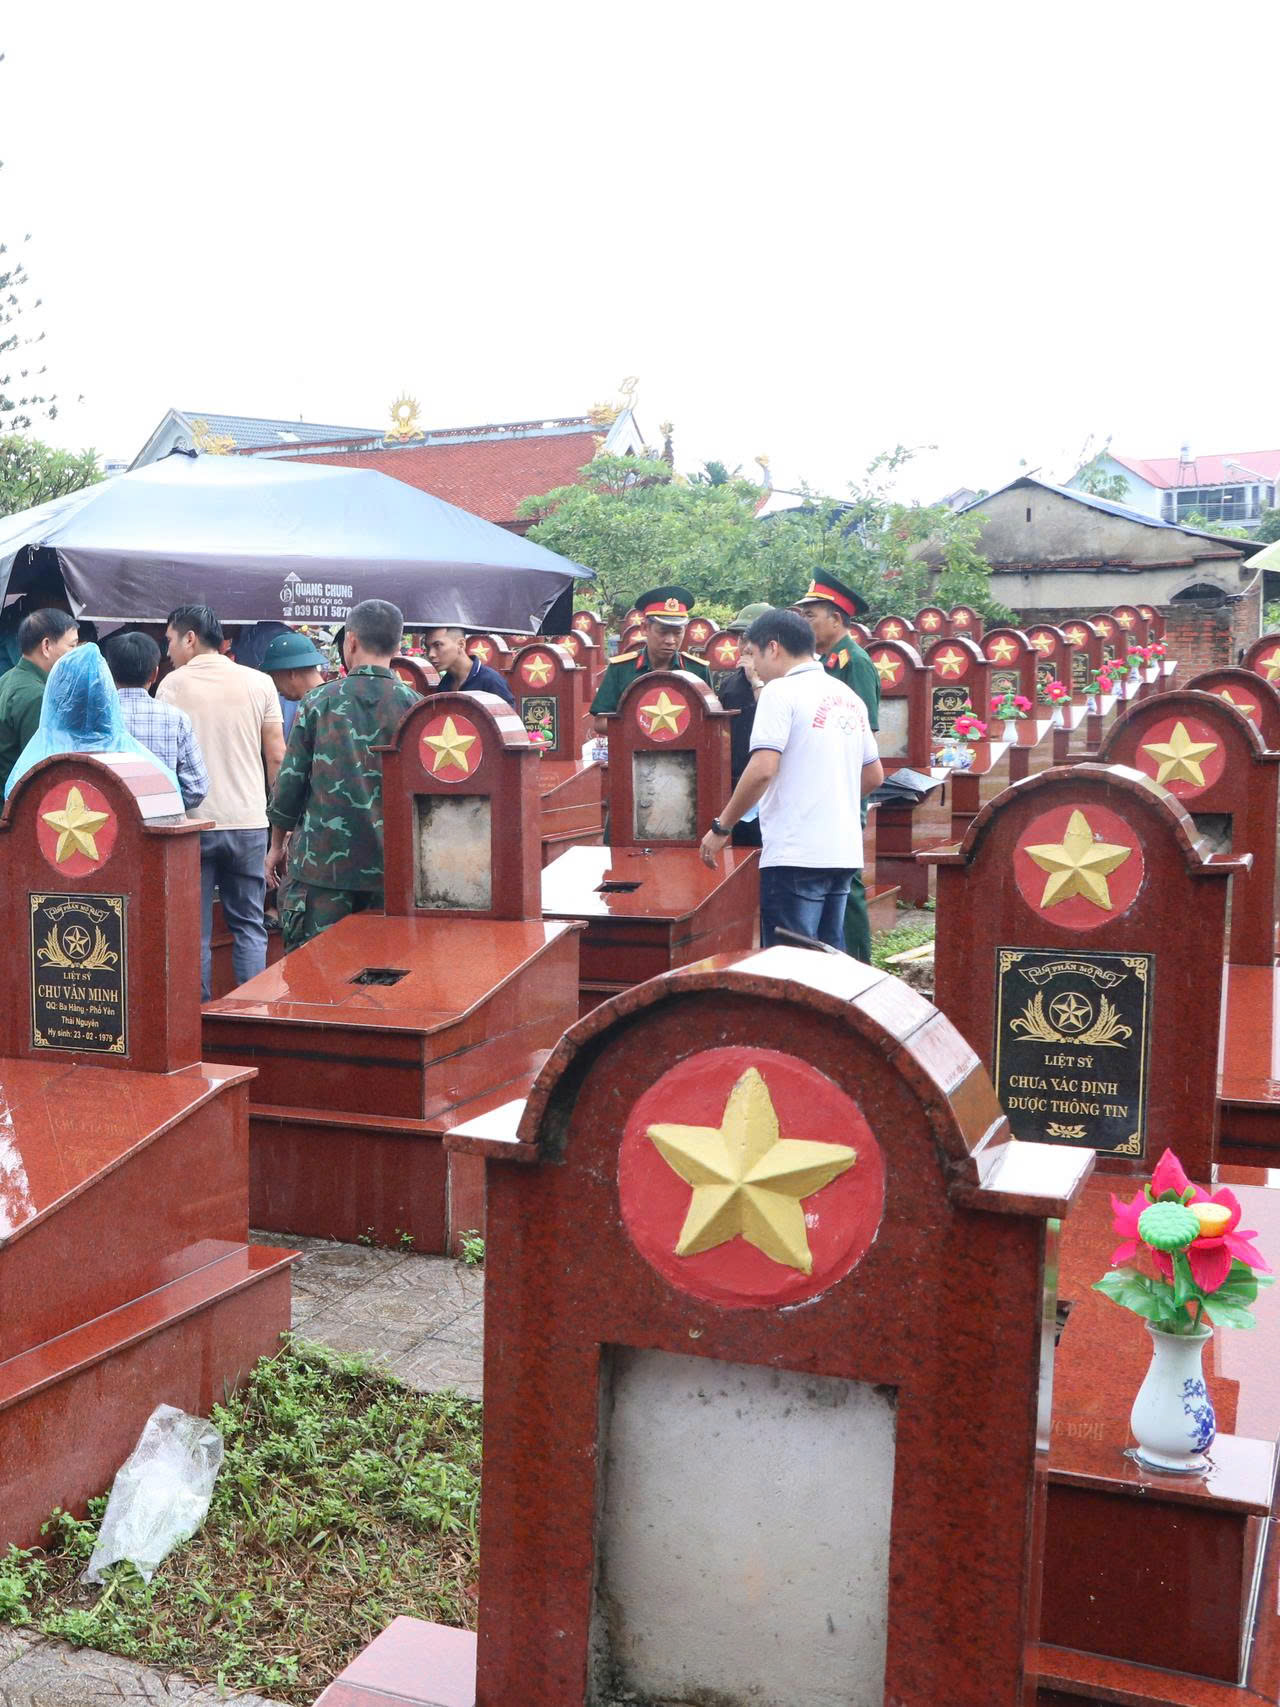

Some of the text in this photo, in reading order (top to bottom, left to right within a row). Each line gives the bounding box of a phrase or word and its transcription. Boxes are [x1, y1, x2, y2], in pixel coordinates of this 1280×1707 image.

[295, 583, 353, 598] QUANG CHUNG
[294, 605, 311, 617] 039
[313, 605, 328, 617] 611
[63, 970, 81, 981] LIỆT
[1052, 962, 1094, 974] PHẦN MỘ
[38, 984, 119, 1003] CHU VĂN MINH
[59, 1002, 68, 1011] Ba
[102, 1006, 116, 1016] Yên
[61, 1015, 99, 1028] Thái Nguyên
[47, 1027, 56, 1037] Hy
[57, 1028, 73, 1038] sinh:
[98, 1033, 113, 1042] 1979
[1044, 1052, 1075, 1069] LIỆT
[1009, 1074, 1118, 1097] CHƯA XÁC ĐỊNH
[1008, 1096, 1129, 1118] ĐƯỢC THÔNG TIN
